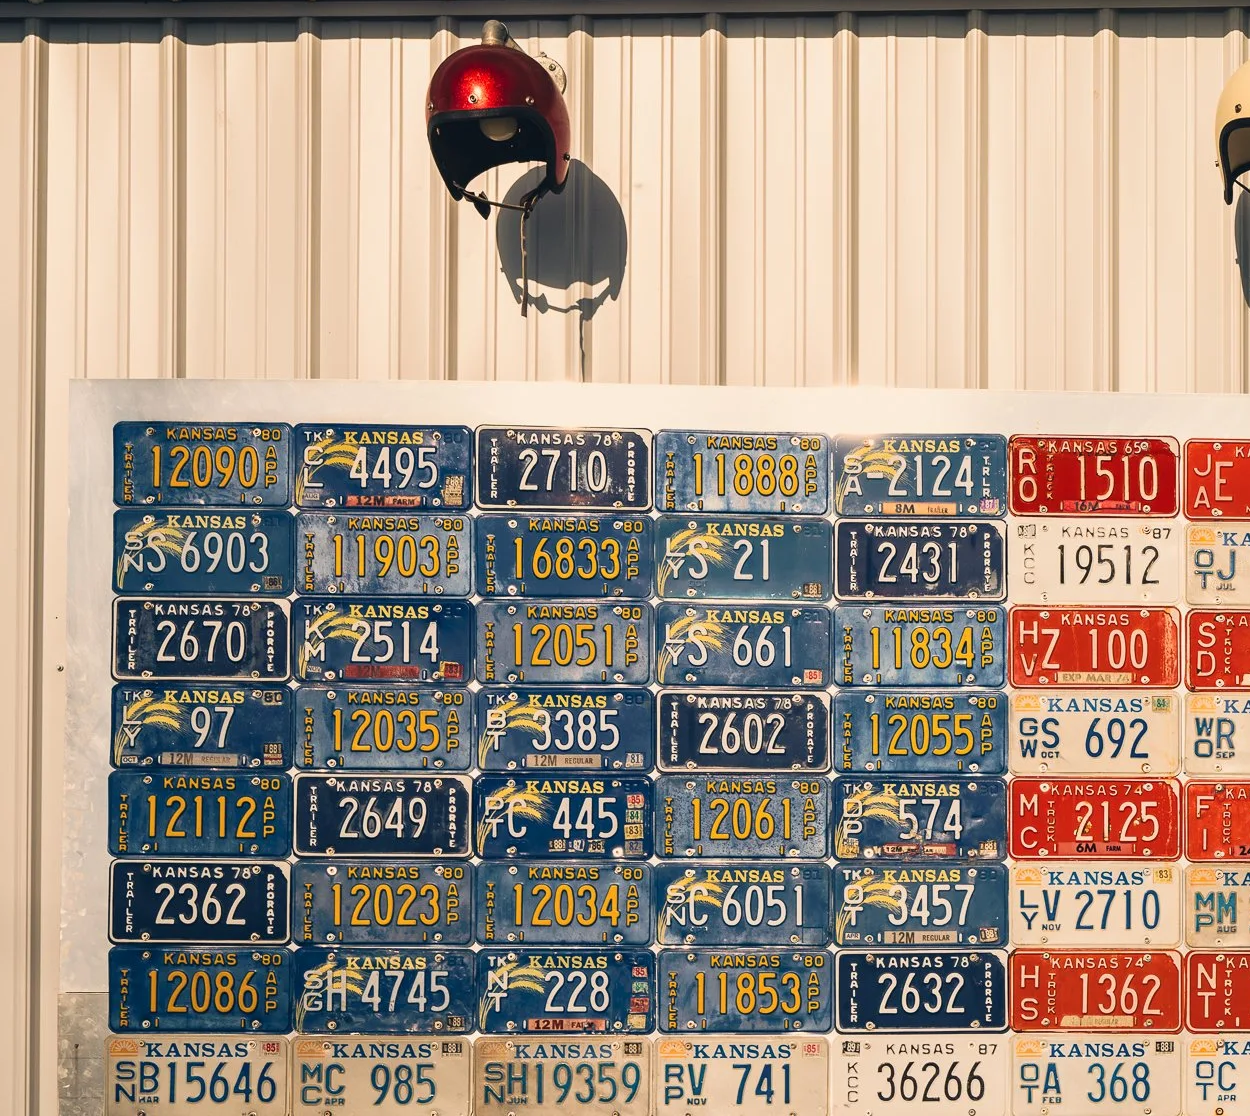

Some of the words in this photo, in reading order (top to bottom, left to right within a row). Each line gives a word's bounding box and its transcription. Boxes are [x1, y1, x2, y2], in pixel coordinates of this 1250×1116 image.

[167, 429, 236, 440] KANSAS
[262, 429, 280, 440] 80
[344, 432, 424, 444] KANSAS
[517, 433, 584, 445] KANSAS
[596, 434, 611, 446] 78
[152, 446, 259, 488] 12090
[350, 447, 438, 488] 4495
[491, 439, 499, 498] TRAILER
[518, 450, 607, 491] 2710
[693, 454, 798, 496] 11888
[1078, 456, 1158, 500] 1510
[1063, 528, 1129, 538] KANSAS
[1152, 529, 1171, 539] 87
[334, 535, 439, 576] 11903
[514, 537, 619, 579] 16833
[878, 543, 957, 582] 2431
[1058, 545, 1159, 584] 19512
[156, 620, 245, 662] 2670
[352, 621, 438, 663] 2514
[513, 624, 613, 666] 12051
[870, 627, 974, 669] 11834
[164, 691, 244, 704] KANSAS
[190, 707, 234, 748] 97
[332, 710, 439, 751] 12035
[533, 710, 620, 751] 3385
[698, 713, 785, 754] 2602
[870, 714, 973, 755] 12055
[169, 754, 193, 764] 12M
[202, 756, 231, 764] REGULAR
[533, 756, 557, 767] 12M
[148, 796, 256, 838] 12112
[339, 797, 427, 838] 2649
[692, 799, 790, 839] 12061
[899, 799, 963, 840] 574
[1075, 802, 1159, 842] 2125
[1076, 843, 1097, 853] 6M
[153, 867, 224, 879] KANSAS
[232, 867, 251, 879] 78
[156, 883, 245, 925] 2362
[332, 883, 439, 926] 12023
[514, 885, 620, 926] 12034
[888, 885, 974, 925] 3457
[1075, 891, 1160, 929] 2710
[148, 971, 258, 1013] 12086
[545, 971, 608, 1012] 228
[696, 973, 801, 1014] 11853
[878, 973, 965, 1014] 2632
[1080, 974, 1161, 1015] 1362
[146, 1043, 248, 1058] KANSAS
[877, 1062, 984, 1102] 36266
